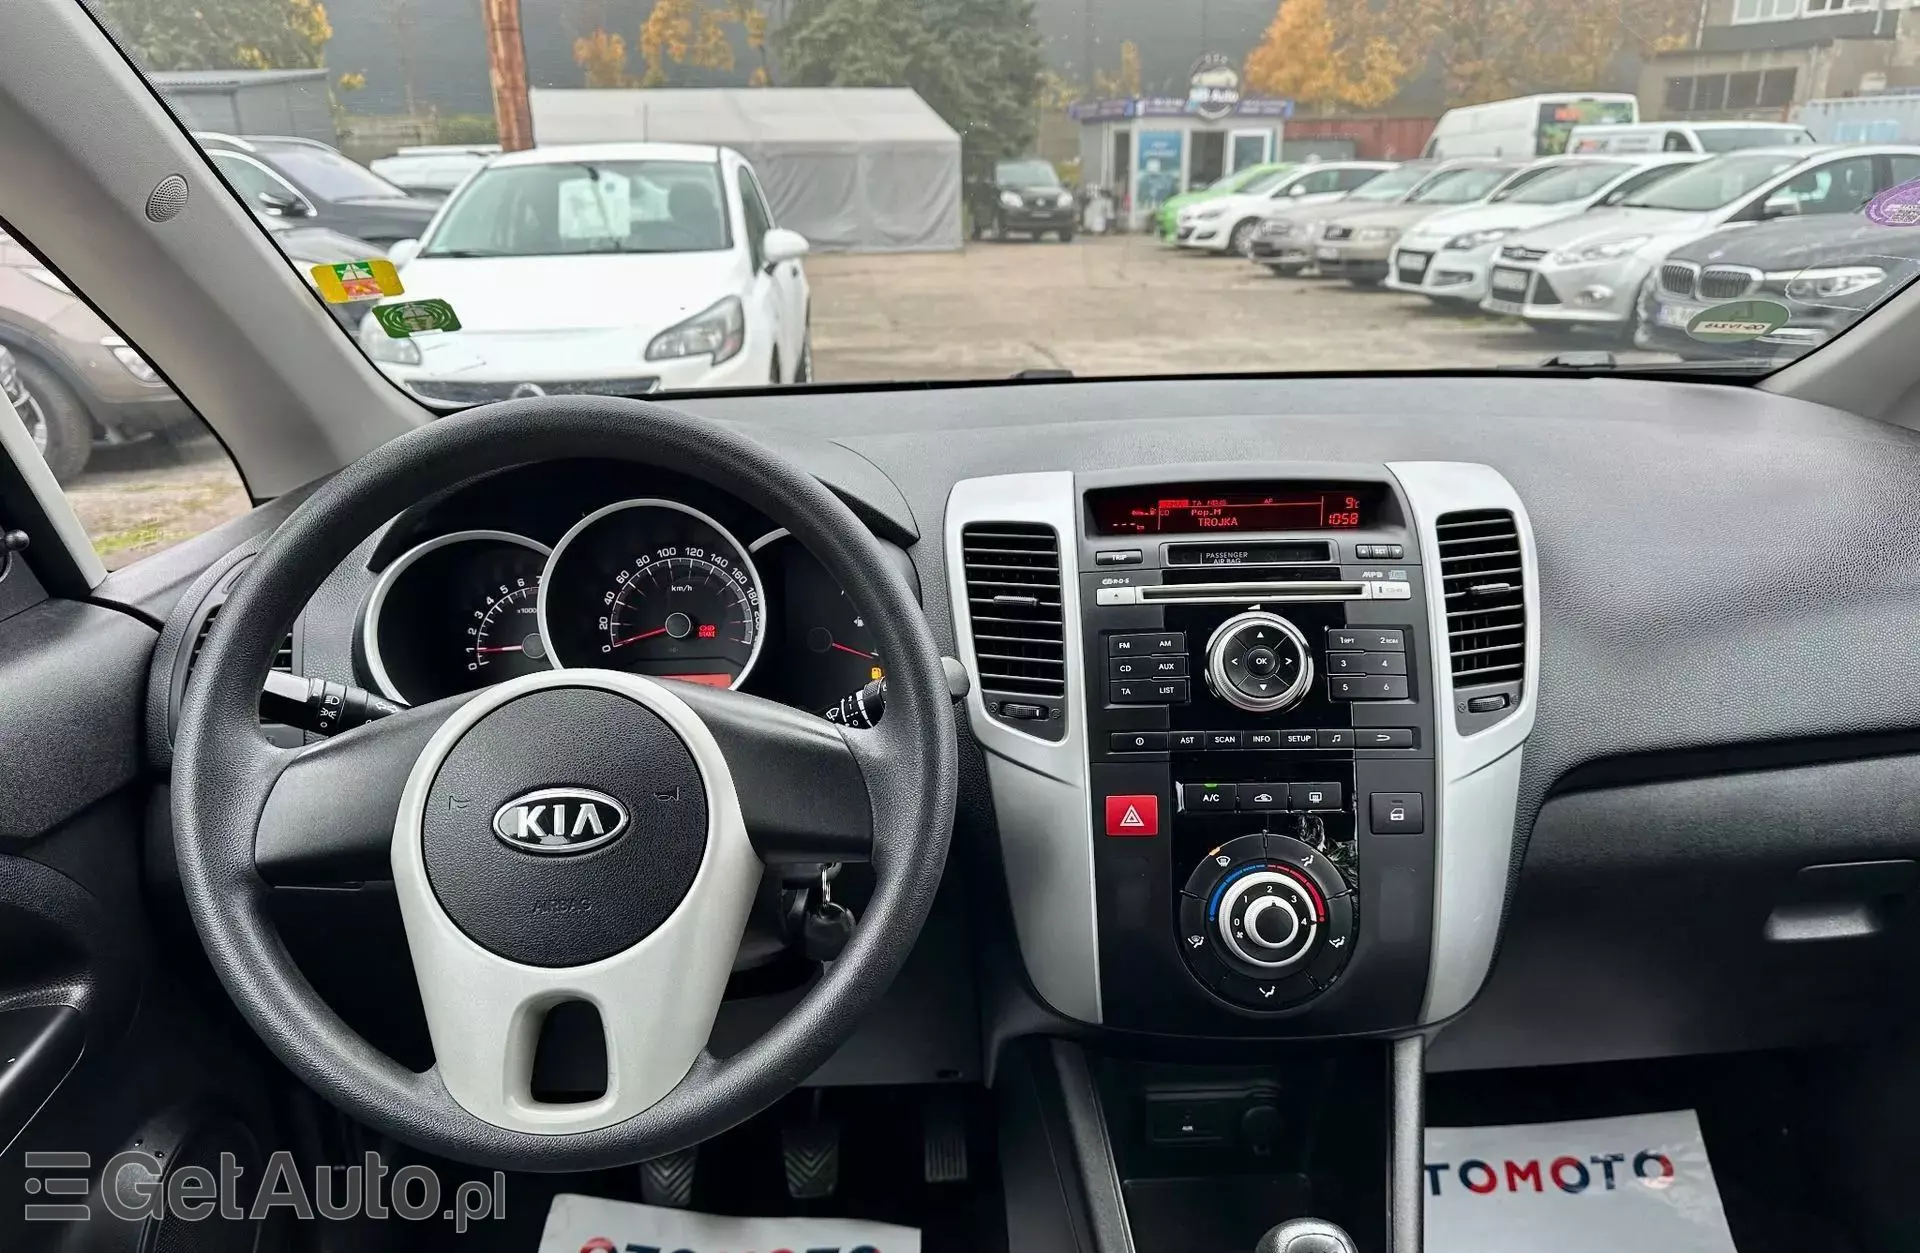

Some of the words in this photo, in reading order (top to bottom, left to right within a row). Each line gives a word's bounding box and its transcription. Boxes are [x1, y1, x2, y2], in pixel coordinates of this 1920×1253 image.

[1198, 517, 1239, 528] TROJKA
[657, 547, 677, 559] 100
[685, 547, 704, 558] 120
[1205, 551, 1249, 559] PASSENGER
[635, 555, 651, 568] 80
[710, 553, 729, 568] 140
[615, 570, 630, 584] 60
[731, 567, 748, 585] 160
[517, 578, 525, 587] 6
[499, 585, 509, 594] 5
[671, 584, 693, 592] km/h
[604, 591, 615, 606] 40
[746, 586, 759, 606] 180
[486, 596, 495, 606] 4
[474, 610, 484, 619] 3
[598, 616, 609, 631] 20
[467, 627, 477, 636] 2
[601, 644, 612, 653] 0
[1255, 657, 1268, 665] OK
[1340, 659, 1347, 667] 3
[467, 662, 478, 671] 0
[1383, 683, 1390, 691] 6
[1214, 736, 1236, 744] SCAN
[1252, 735, 1271, 743] INFO
[1287, 735, 1312, 743] SETUP
[1202, 793, 1220, 802] A/C
[516, 803, 604, 838] KIA
[1266, 885, 1273, 893] 2
[1290, 895, 1297, 903] 3
[1234, 918, 1240, 926] 0
[1301, 917, 1307, 925] 4
